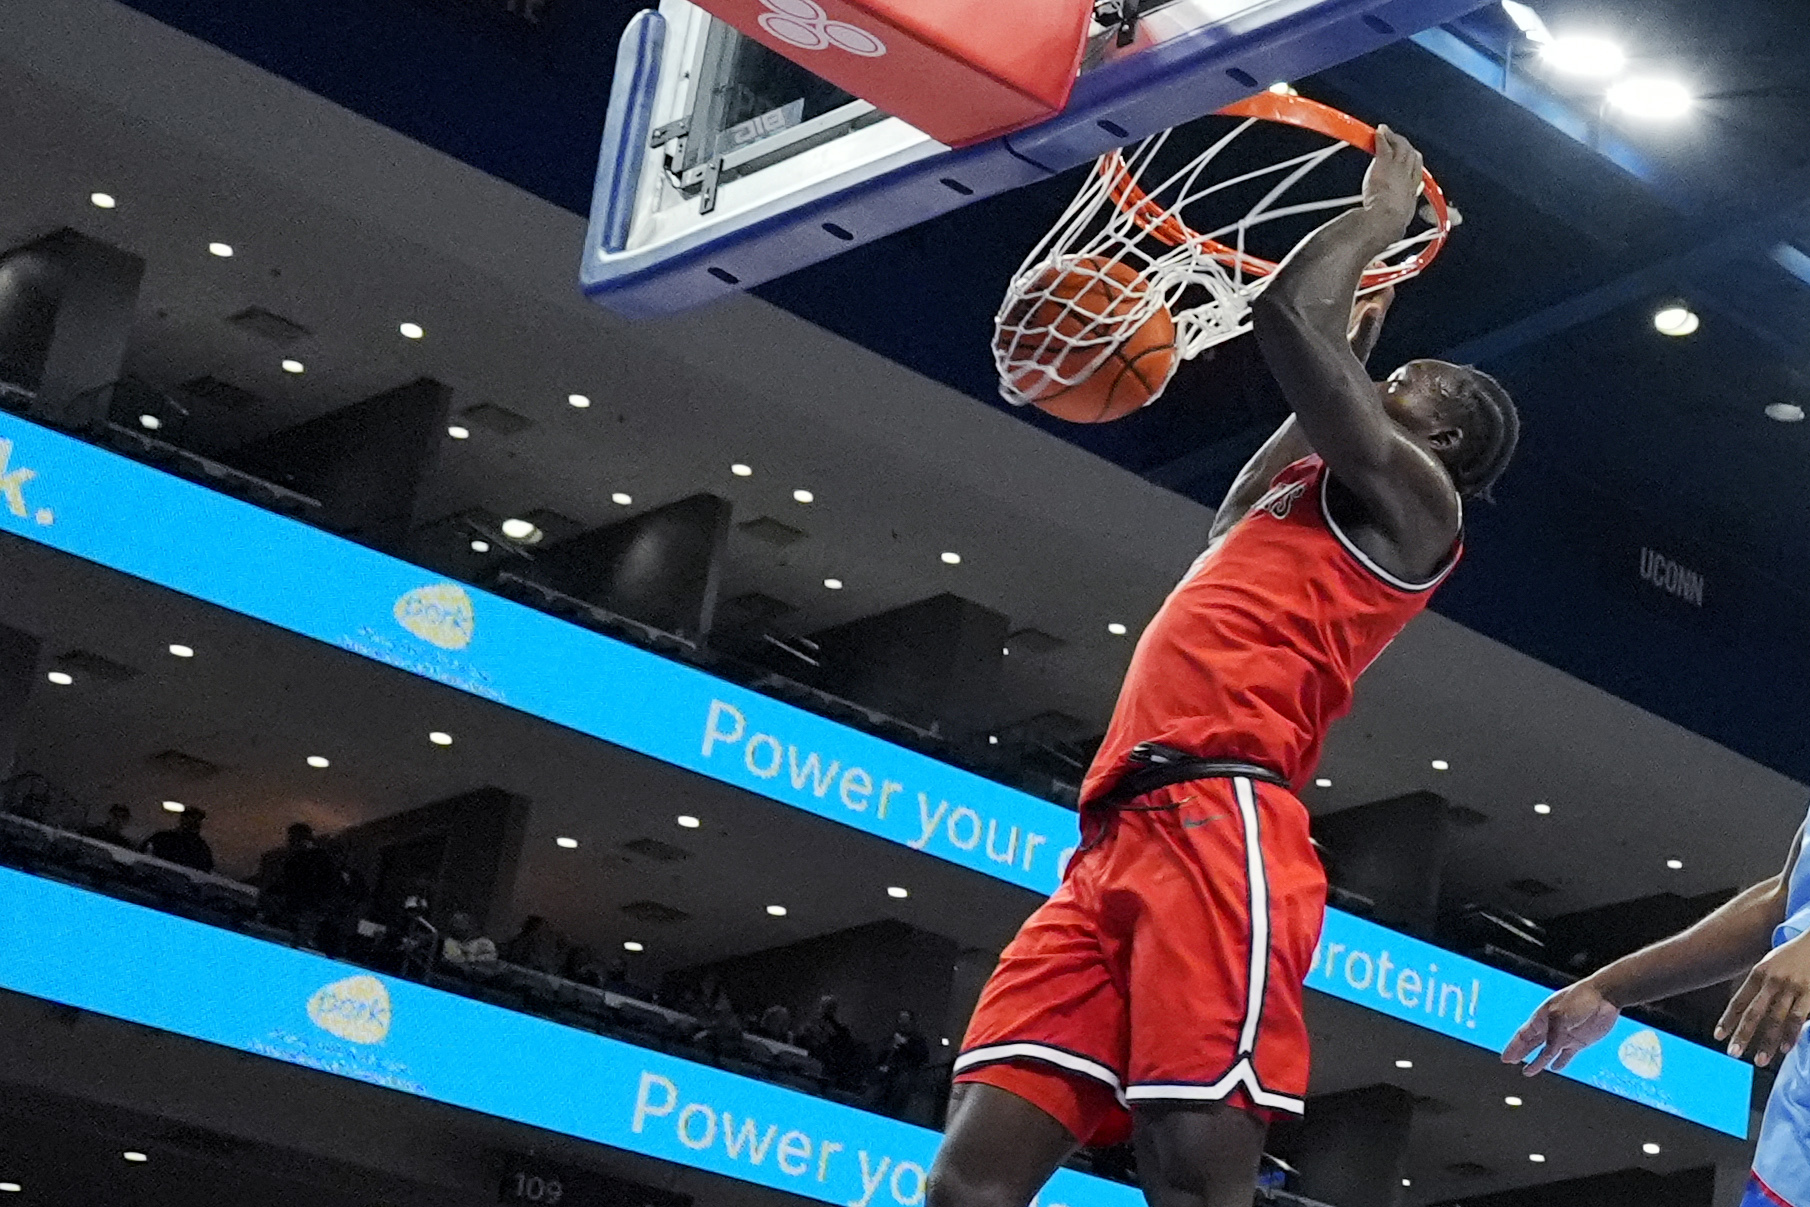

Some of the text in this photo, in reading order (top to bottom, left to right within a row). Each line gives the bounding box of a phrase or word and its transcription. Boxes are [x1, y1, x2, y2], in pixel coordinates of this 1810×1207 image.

[1640, 547, 1703, 606] UCONN
[700, 699, 1046, 871] Power your
[632, 1069, 843, 1181] Power
[514, 1173, 563, 1204] 109
